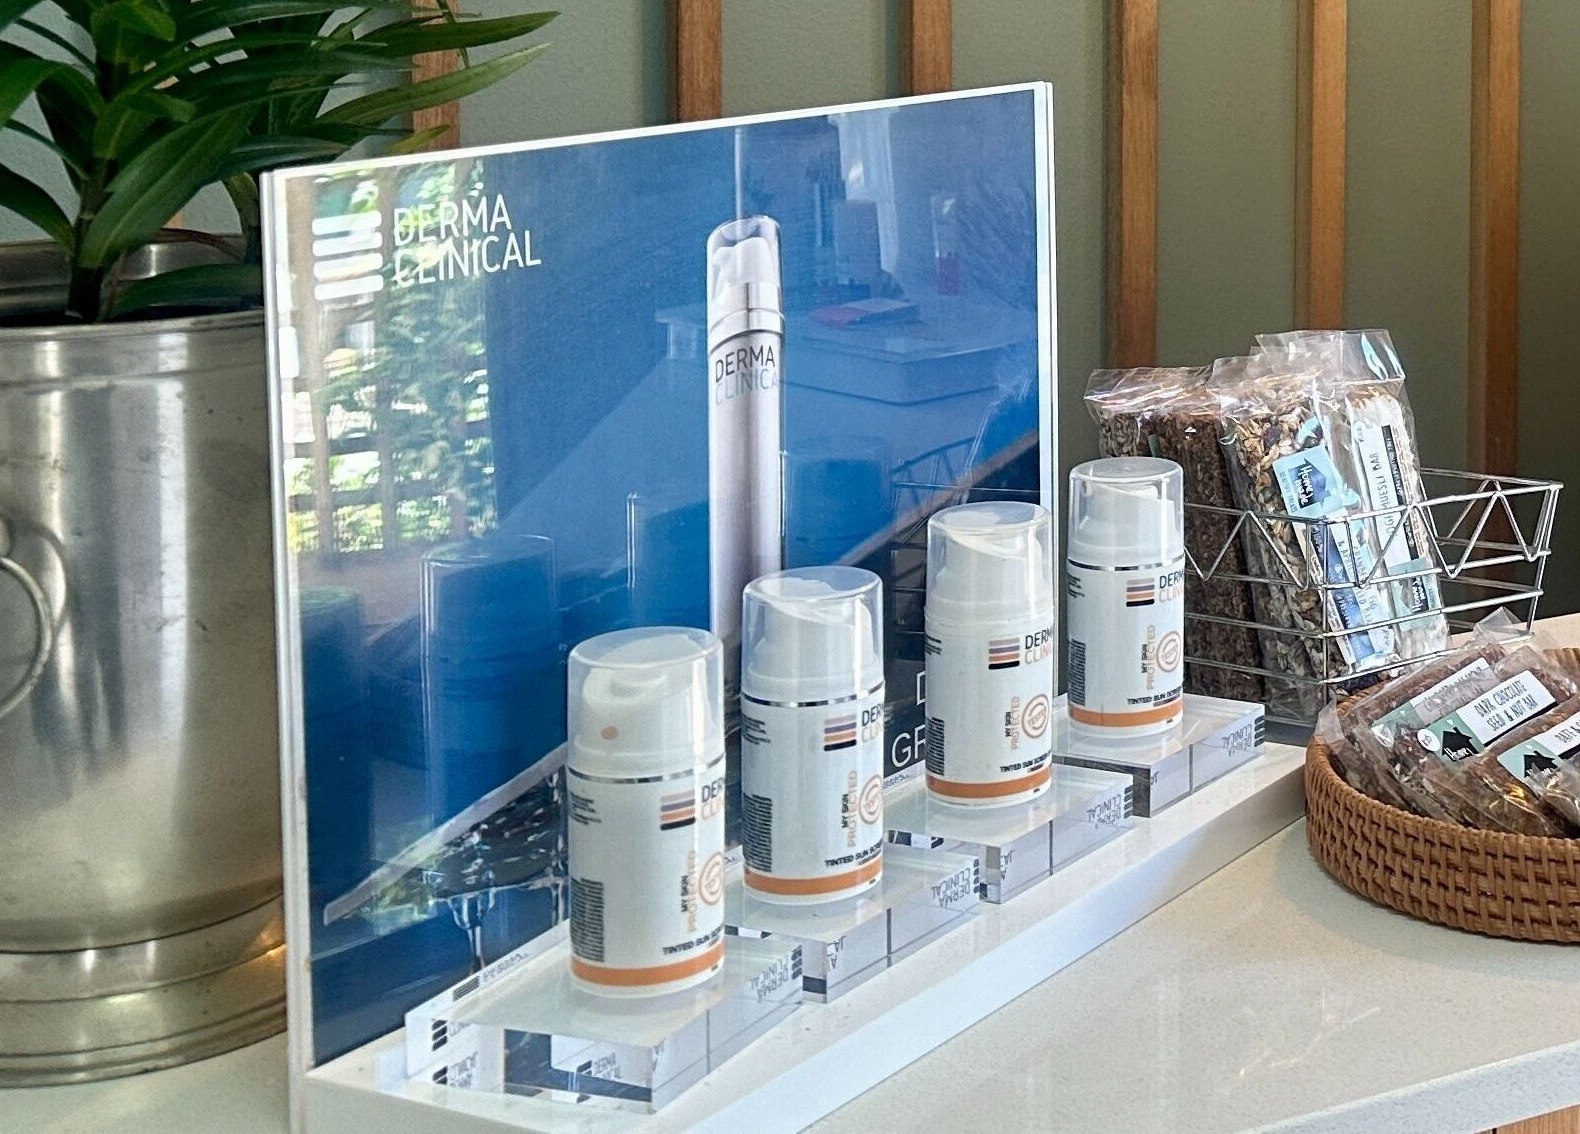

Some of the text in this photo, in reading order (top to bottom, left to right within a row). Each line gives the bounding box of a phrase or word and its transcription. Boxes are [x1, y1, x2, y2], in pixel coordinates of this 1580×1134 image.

[393, 193, 512, 246] DERMA
[393, 230, 542, 289] CLINICAL
[715, 344, 775, 383] DERMA
[715, 368, 778, 406] CLINICA
[1146, 625, 1155, 690] PROTECTED
[1127, 696, 1152, 705] TINTED
[1473, 700, 1496, 718] DARK
[1494, 679, 1527, 710] CHOCOLATE
[1486, 714, 1507, 732] SEED
[1506, 710, 1514, 722] &
[1511, 700, 1527, 720] NUT
[1011, 696, 1020, 750] PROTECTED
[847, 770, 858, 847] PROTECTED
[825, 854, 854, 867] TINTED
[855, 850, 869, 860] SUN
[687, 850, 697, 932] PROTECTED
[662, 941, 694, 955] TINTED
[695, 935, 710, 946] SUN
